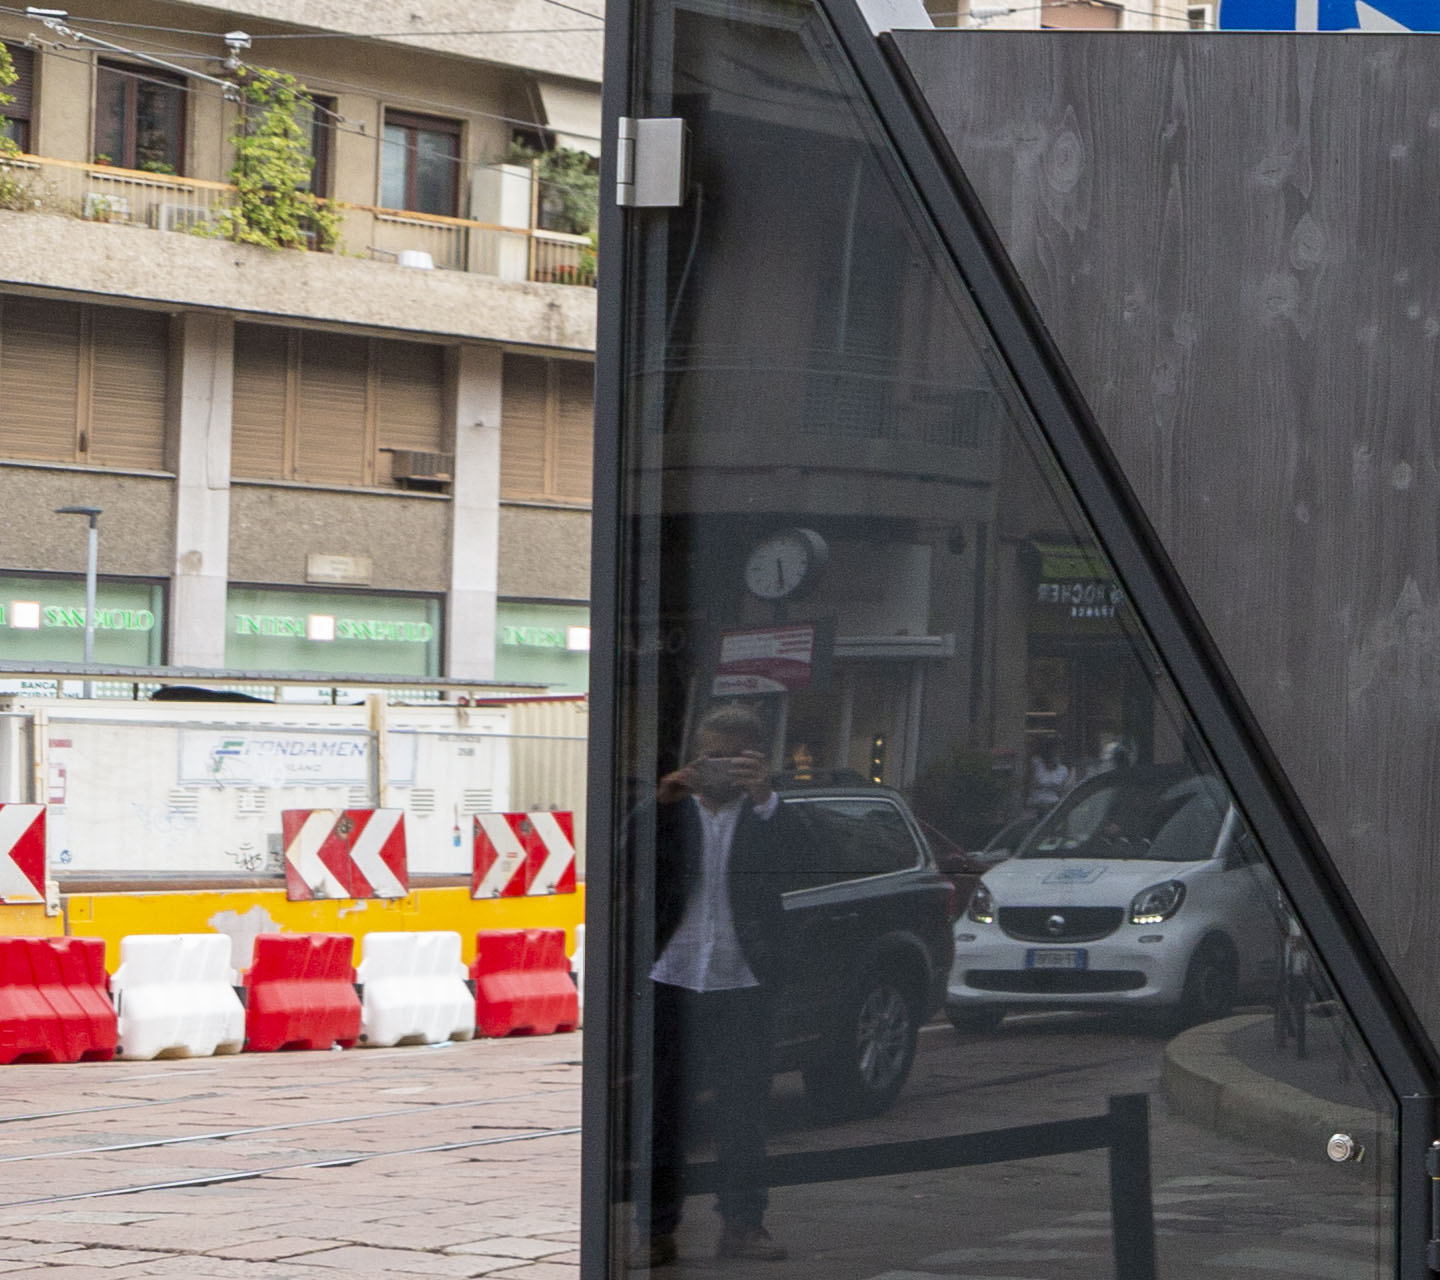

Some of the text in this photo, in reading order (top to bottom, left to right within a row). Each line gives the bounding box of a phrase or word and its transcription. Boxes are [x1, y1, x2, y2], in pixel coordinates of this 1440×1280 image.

[44, 605, 154, 631] SANAOLO
[235, 614, 305, 638] INTESA
[338, 618, 433, 643] SANPAOLO
